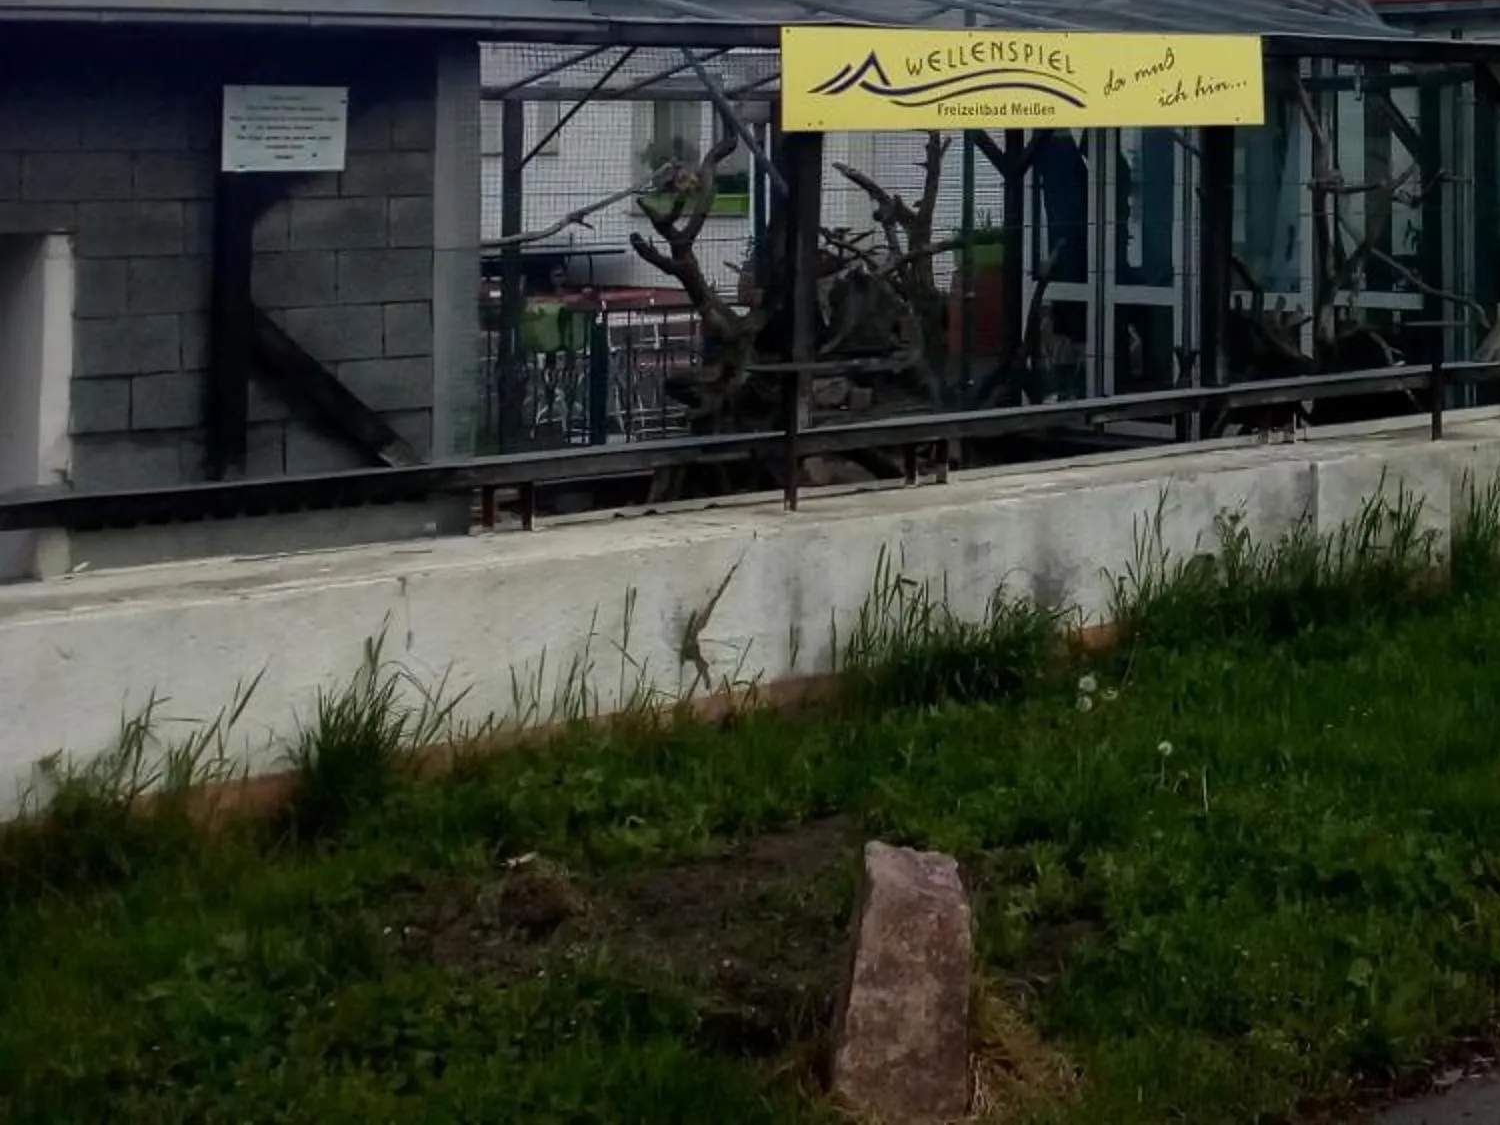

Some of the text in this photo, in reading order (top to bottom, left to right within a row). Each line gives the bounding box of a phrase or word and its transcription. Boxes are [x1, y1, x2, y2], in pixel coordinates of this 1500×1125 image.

[905, 40, 1076, 76] WELLENSPIEL
[1103, 67, 1127, 97] da
[1158, 79, 1188, 107] ich
[936, 102, 1056, 117] Freizeitbad Meißen
